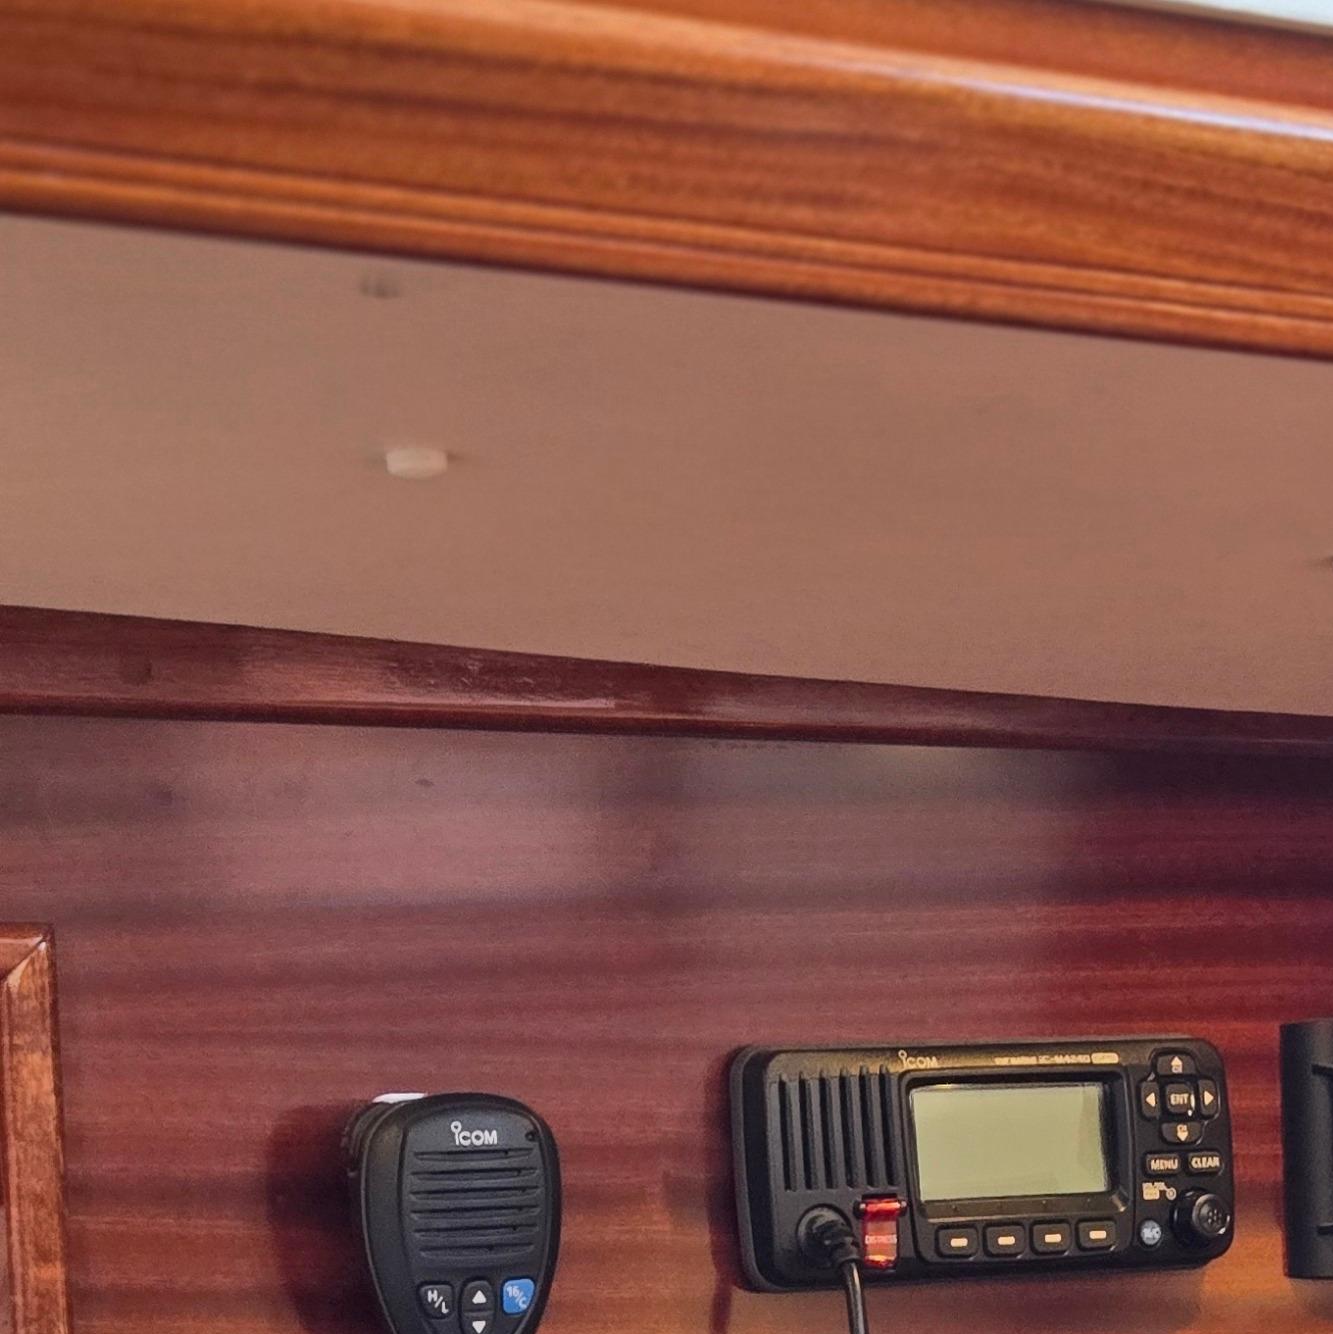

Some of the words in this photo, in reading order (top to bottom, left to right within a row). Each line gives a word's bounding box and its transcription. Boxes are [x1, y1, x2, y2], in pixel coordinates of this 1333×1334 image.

[1170, 1093, 1189, 1106] ENT
[1151, 1159, 1178, 1170] MENU
[1191, 1157, 1220, 1169] CLEAR
[427, 1289, 449, 1314] H/L
